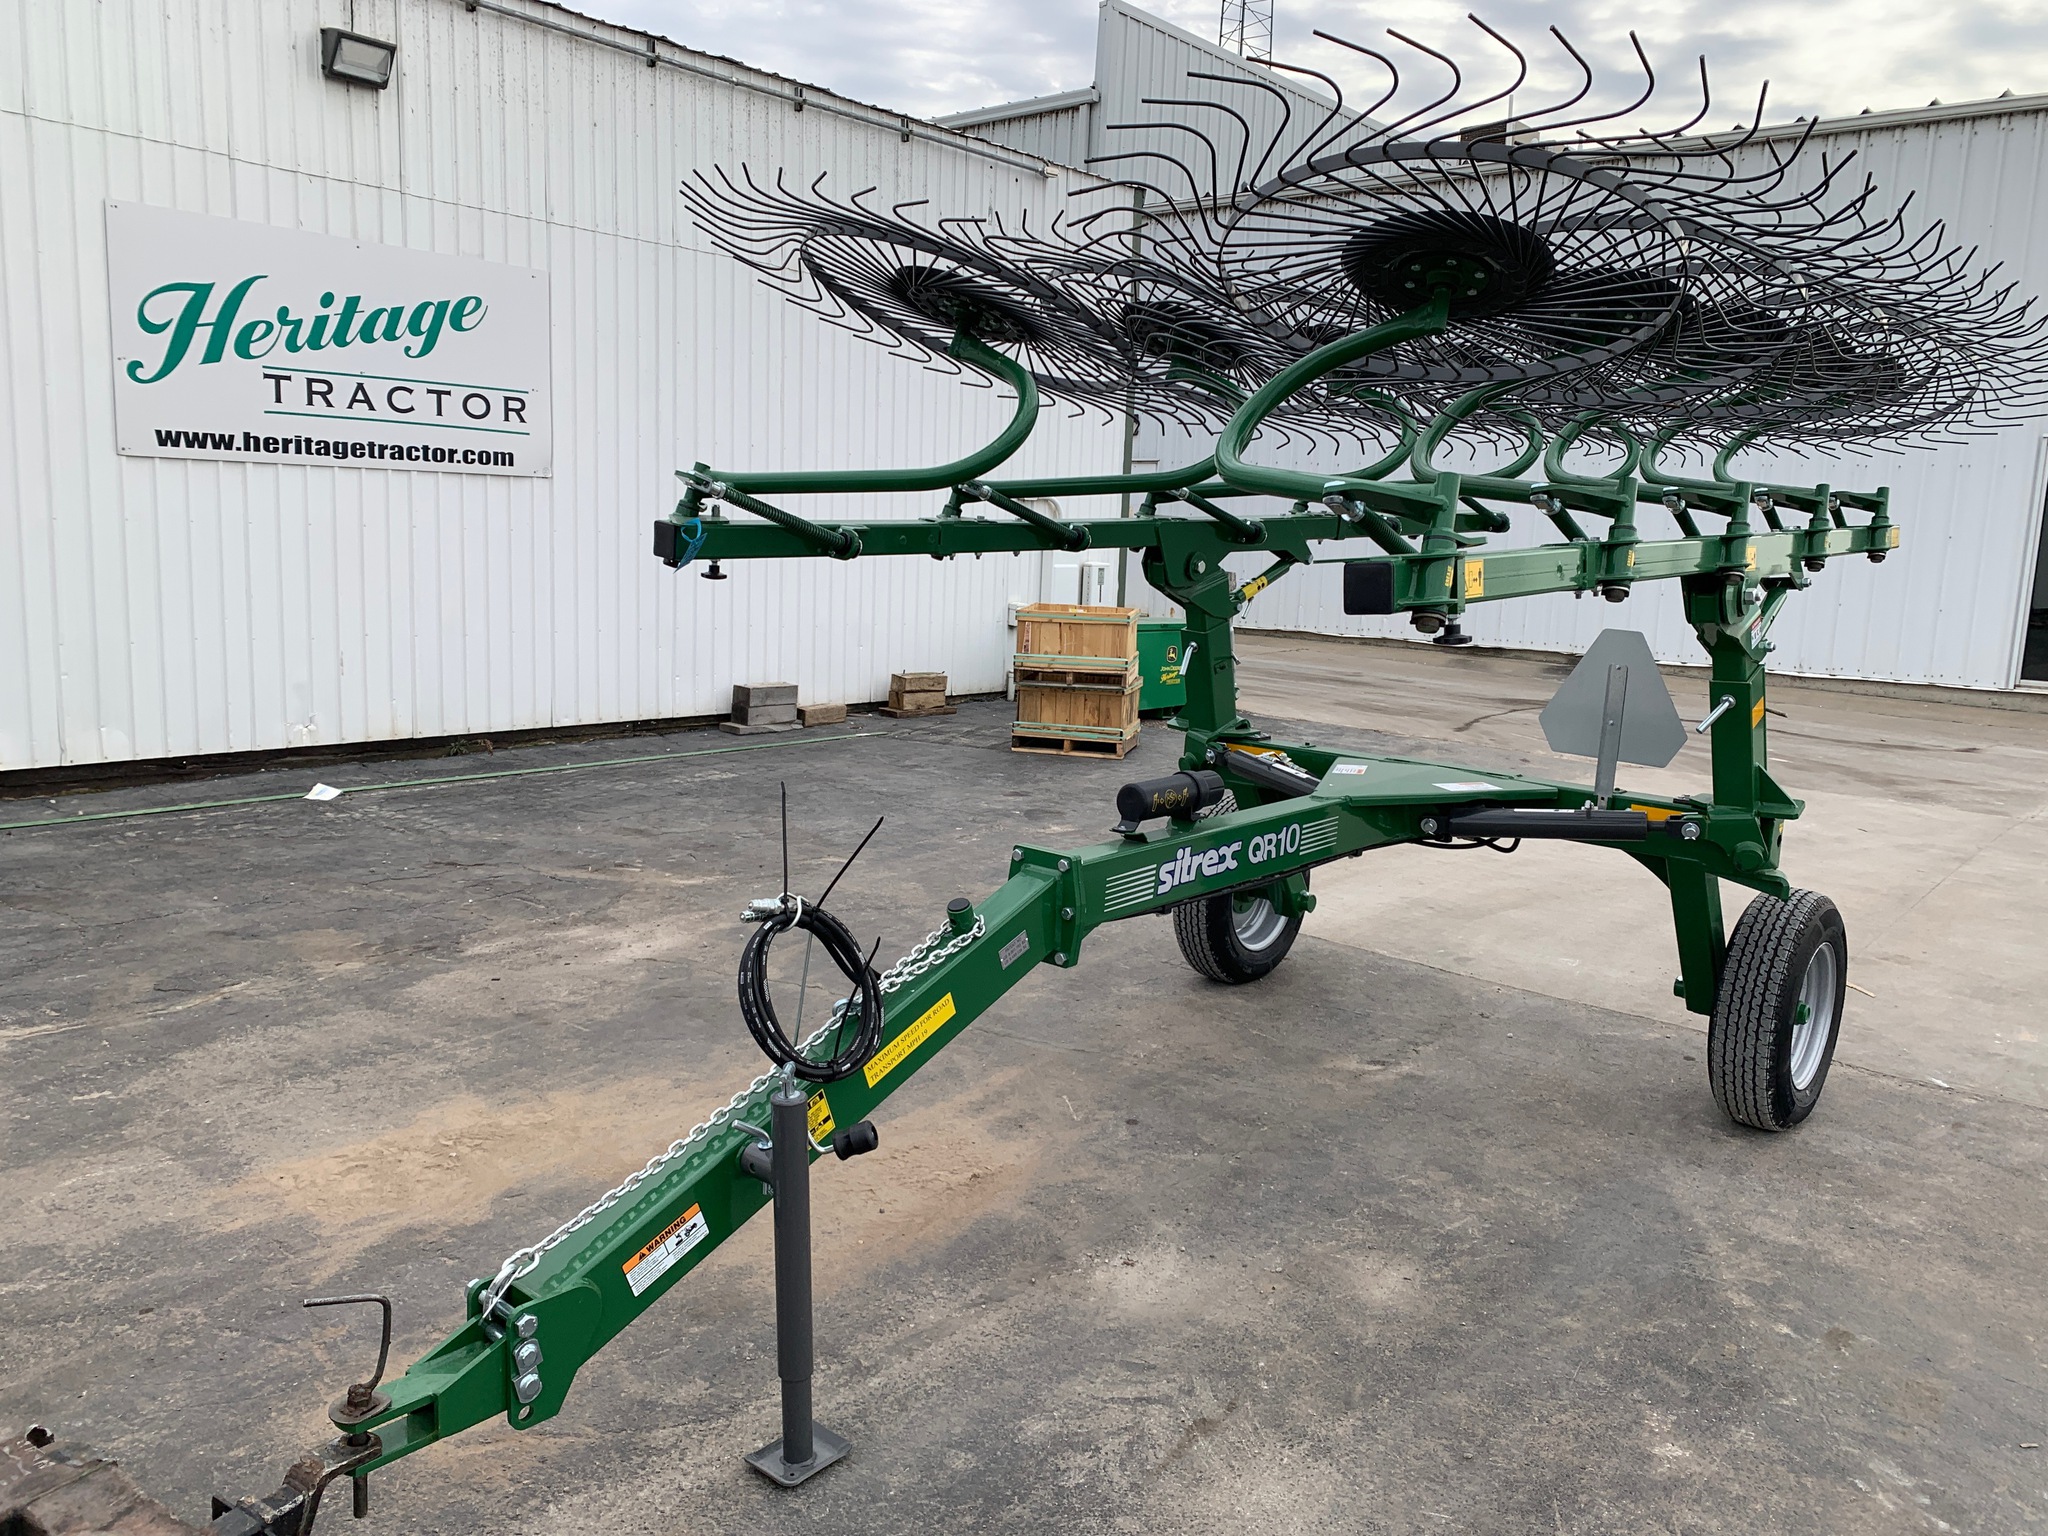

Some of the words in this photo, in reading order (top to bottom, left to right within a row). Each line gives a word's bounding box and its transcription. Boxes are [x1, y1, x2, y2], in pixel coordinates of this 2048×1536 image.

[126, 274, 489, 385] Heritage
[262, 371, 528, 424] TRACTOR
[154, 428, 515, 467] www.heritagetractor.com
[1157, 840, 1243, 896] sitrex
[1248, 823, 1301, 865] QR10
[867, 1041, 900, 1073] MAXIMUM
[900, 1024, 920, 1043] SPEED
[920, 1013, 933, 1028] FOR
[932, 998, 950, 1017] ROAD
[870, 1047, 906, 1082] TRANSPORT
[906, 1036, 921, 1051] MPH
[921, 1028, 928, 1038] 19
[646, 1216, 687, 1253] WARNING
